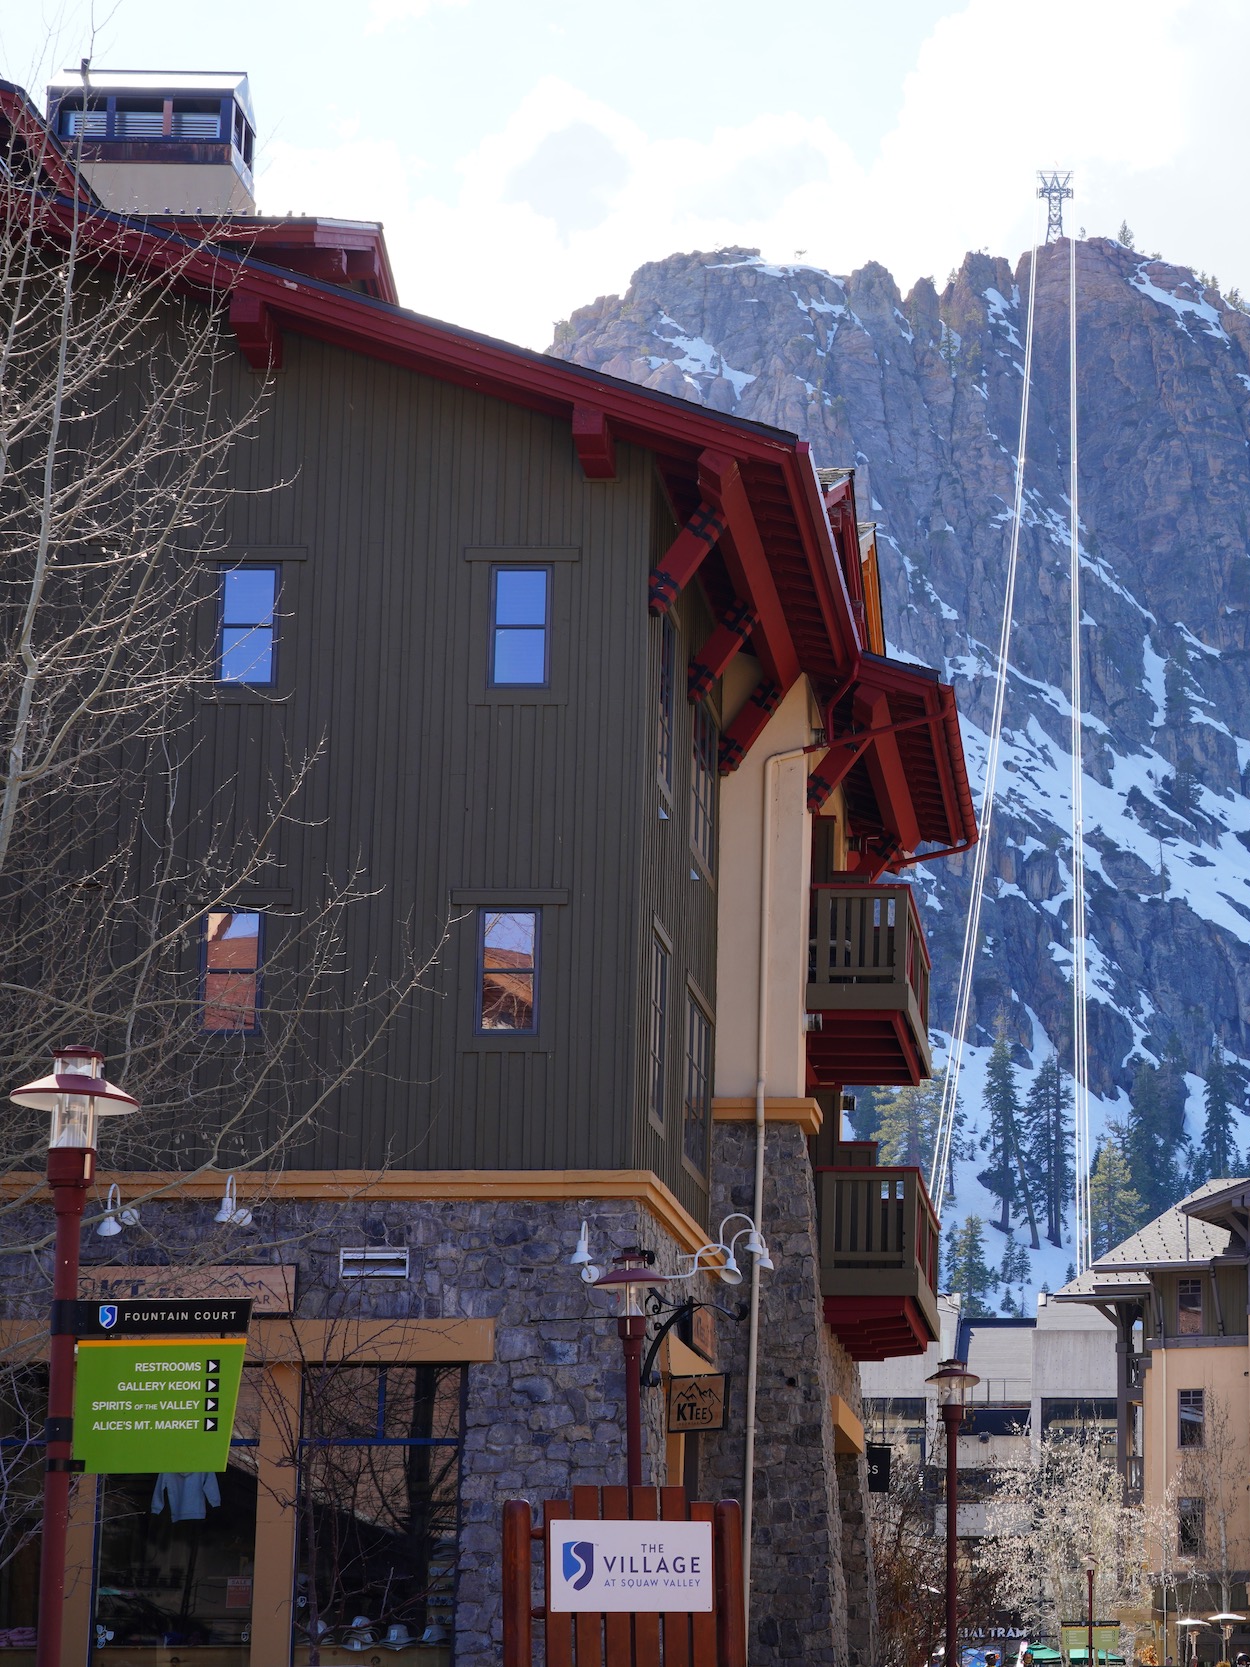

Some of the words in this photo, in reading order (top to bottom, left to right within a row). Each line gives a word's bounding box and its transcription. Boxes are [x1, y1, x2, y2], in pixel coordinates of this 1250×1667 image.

[124, 1312, 189, 1321] FOUNTAIN
[194, 1311, 237, 1320] COURT
[135, 1362, 202, 1372] RESTROOMS
[117, 1382, 166, 1391] GALLERY
[168, 1381, 201, 1391] KEOKI
[92, 1401, 132, 1411] SPIRITS
[160, 1400, 200, 1410] VALLEY
[92, 1421, 132, 1430] ALICE'S
[134, 1420, 153, 1430] MT.
[155, 1420, 199, 1430] MARKET
[641, 1543, 664, 1553] THE
[603, 1556, 700, 1573] VILLAGE
[604, 1579, 616, 1587] AT
[621, 1578, 659, 1588] SQUAW
[663, 1578, 701, 1587] VALLEY
